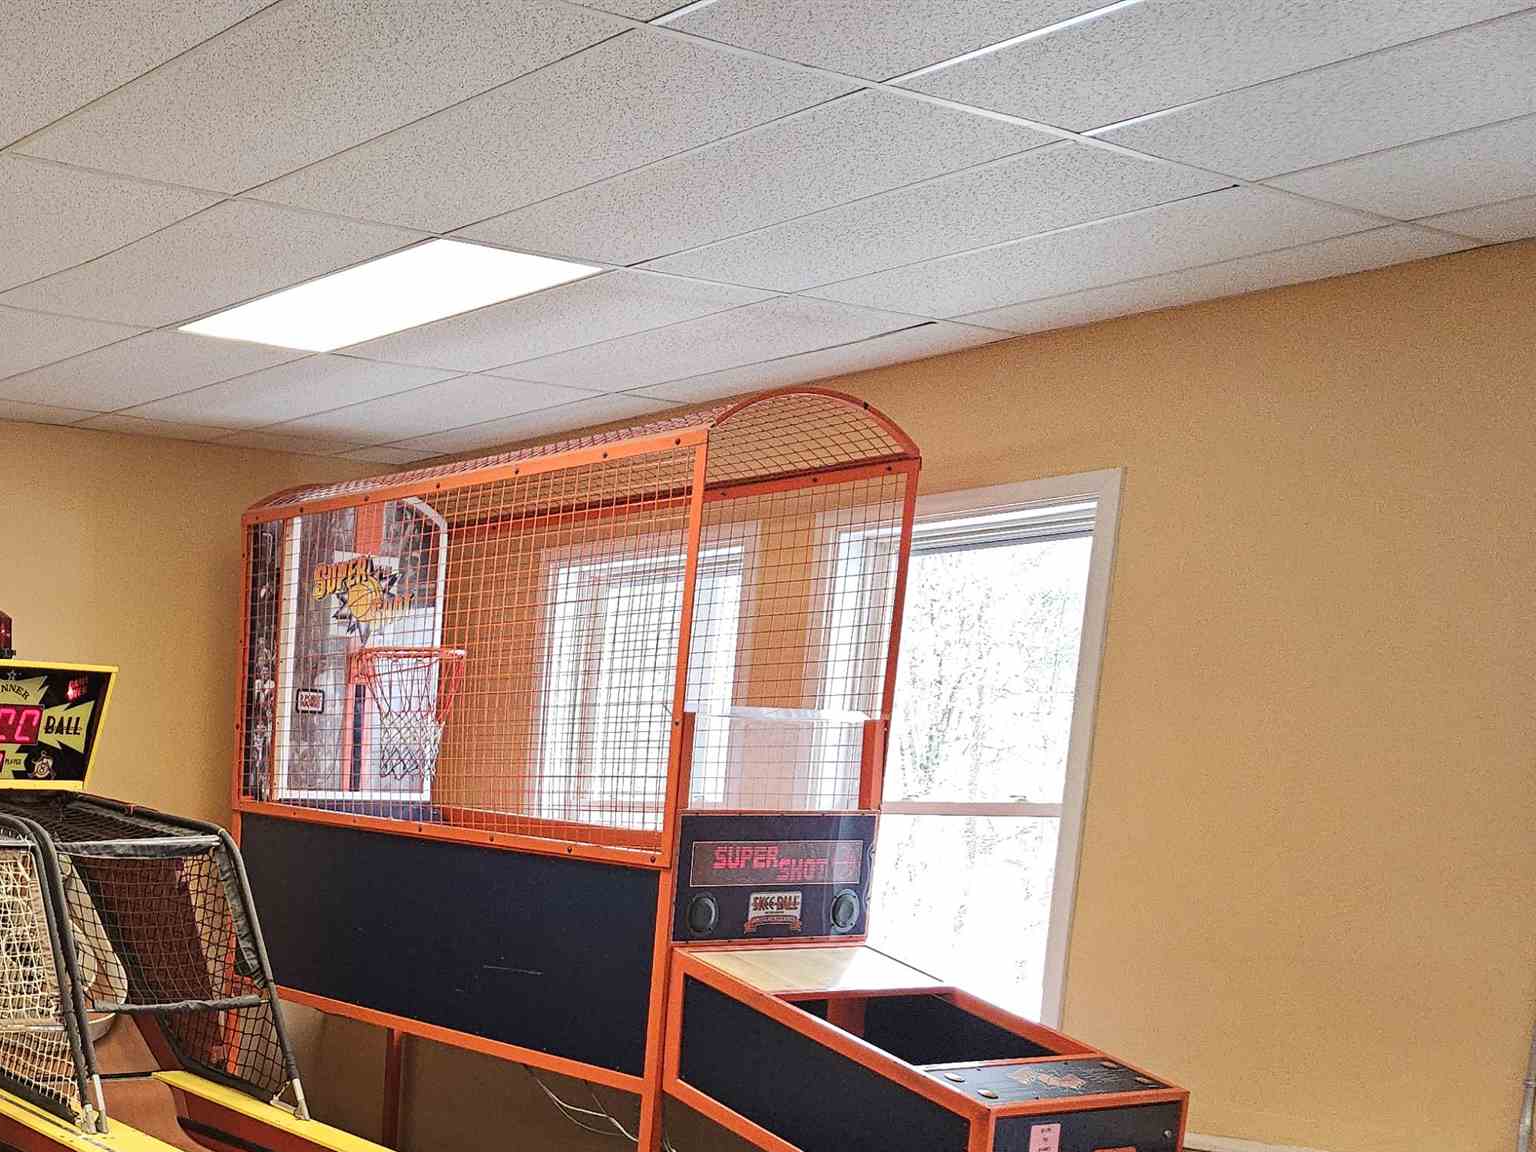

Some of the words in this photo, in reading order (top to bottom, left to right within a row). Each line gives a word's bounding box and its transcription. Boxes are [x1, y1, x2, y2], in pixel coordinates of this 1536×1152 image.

[45, 715, 82, 735] BALL
[713, 846, 780, 869] SUPER
[776, 859, 828, 880] SHOT
